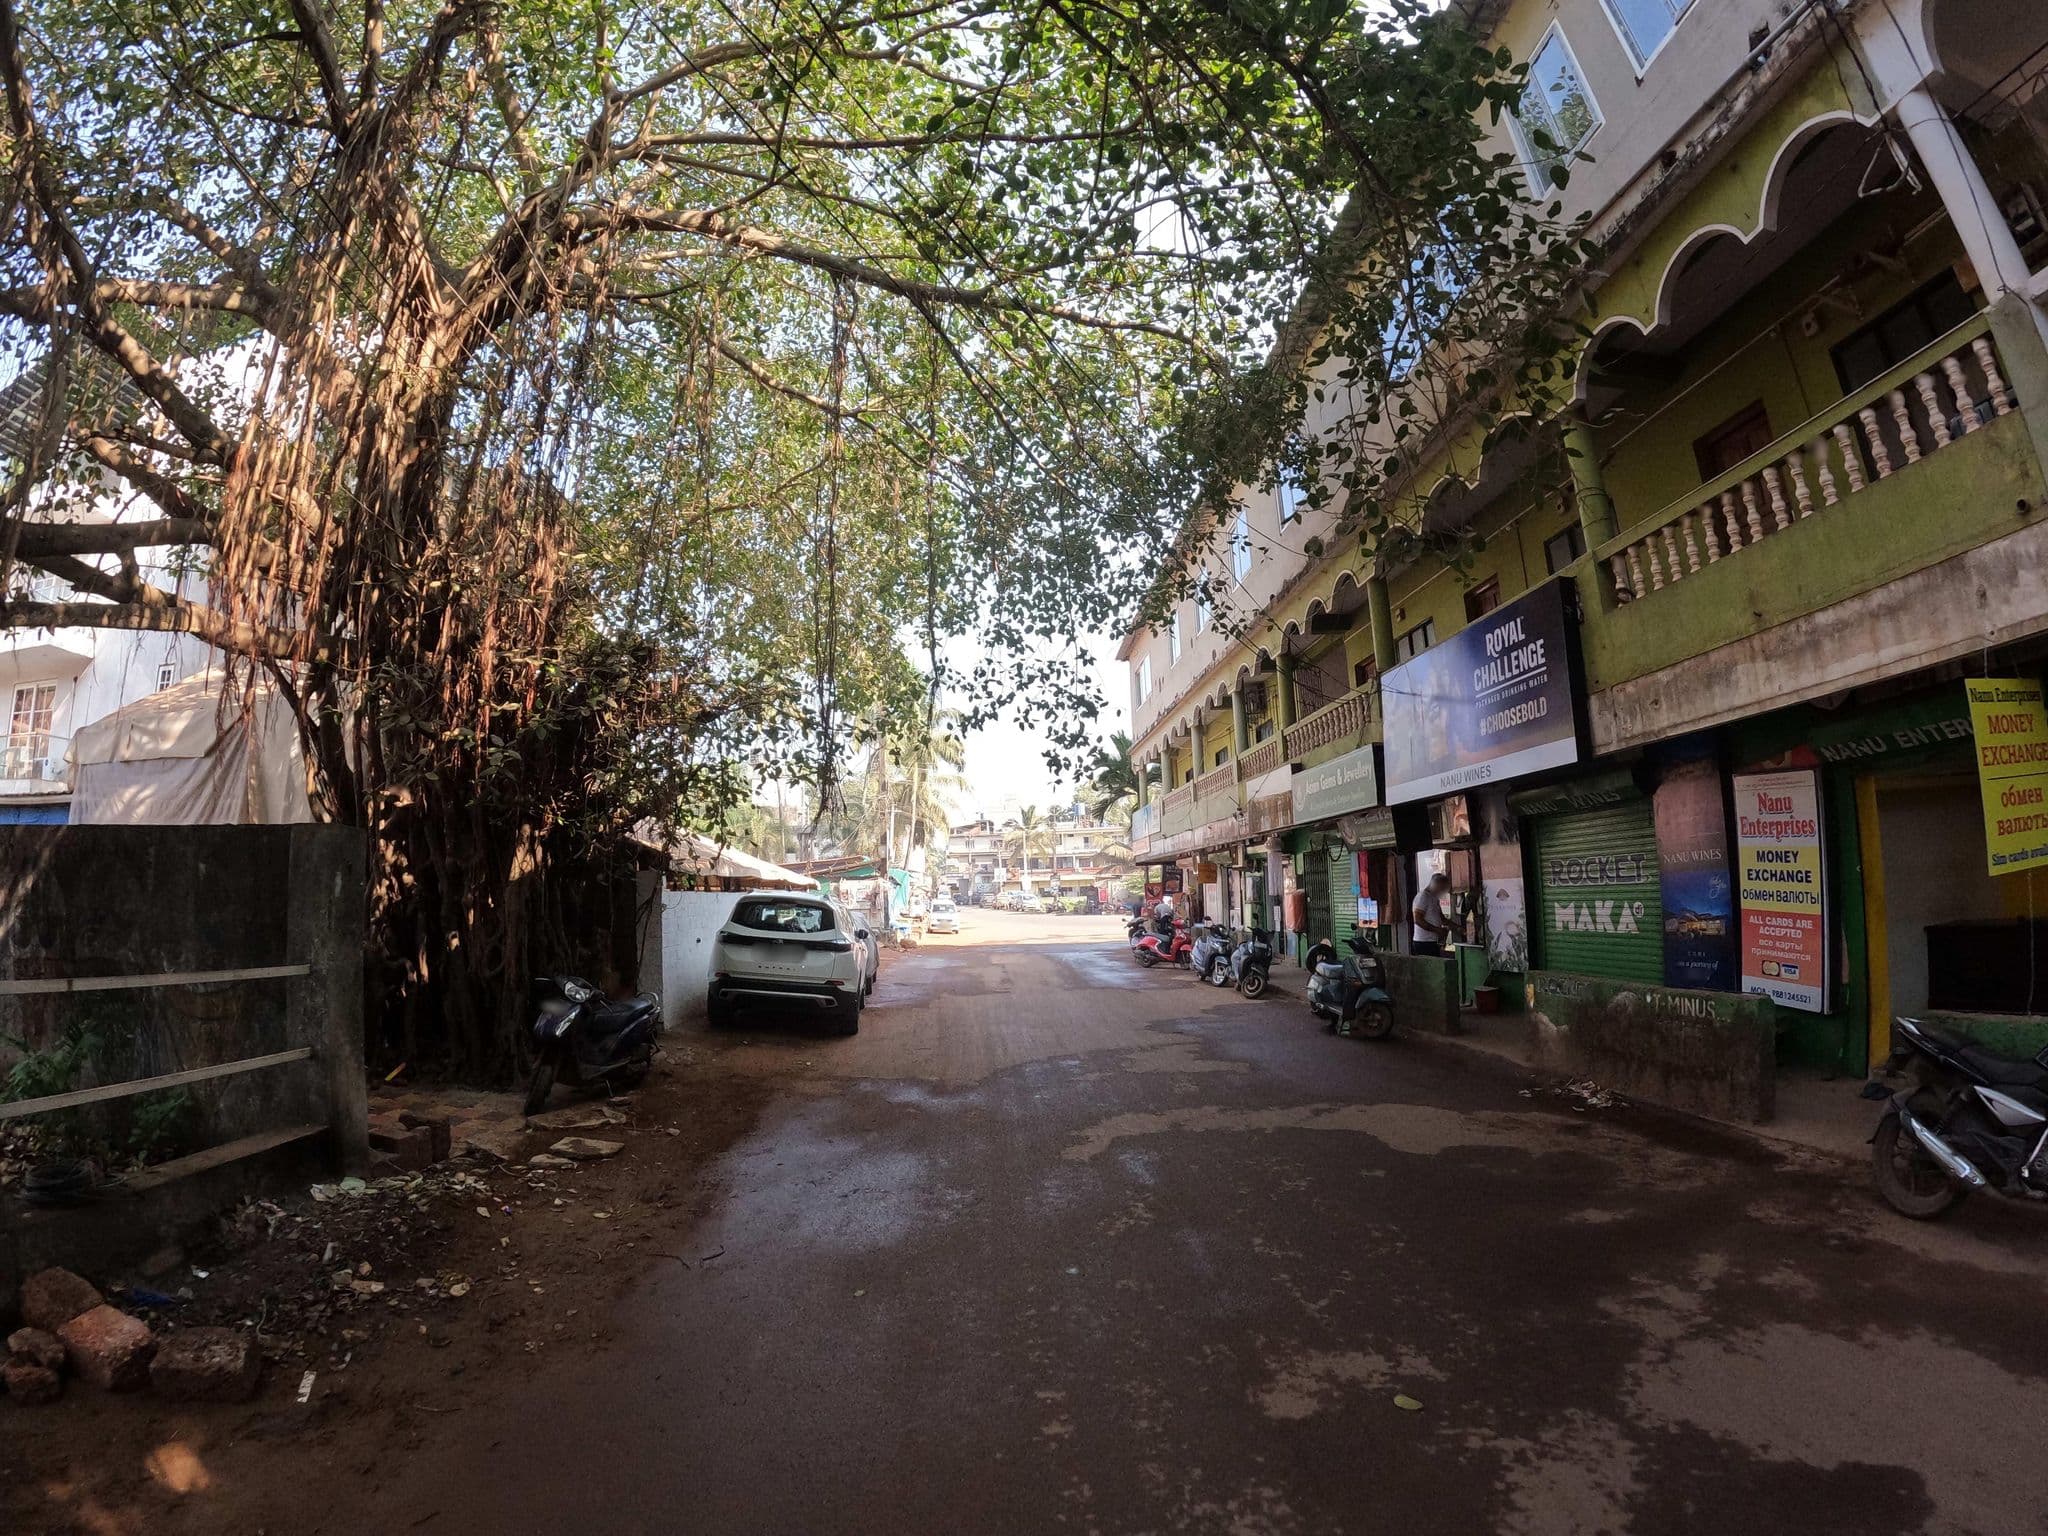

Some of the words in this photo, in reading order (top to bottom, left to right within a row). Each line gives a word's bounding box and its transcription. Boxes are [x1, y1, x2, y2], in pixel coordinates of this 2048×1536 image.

[1485, 616, 1526, 658] ROYAL
[1473, 638, 1546, 691] CHALLENGE
[1529, 673, 1548, 690] WATER
[1969, 687, 1993, 703] Nanu
[1480, 696, 1549, 736] #CHOOSEBOLD
[1987, 713, 2034, 735] MONEY
[1821, 735, 1888, 763] NANU
[1893, 716, 1972, 749] ENTER
[1440, 773, 1463, 788] NANU
[1464, 764, 1492, 783] WINES
[1567, 790, 1622, 811] WINES
[1757, 792, 1794, 815] Nanu
[2000, 785, 2043, 807] обмен
[1740, 815, 1817, 843] Enterprises
[1663, 851, 1690, 864] NANU
[1691, 848, 1722, 862] WINES
[1756, 850, 1800, 864] MONEY
[1548, 853, 1647, 887] ROCKET
[1746, 868, 1813, 884] EXCHANGE
[1776, 890, 1820, 905] валюты
[1554, 900, 1641, 934] MAKA
[1749, 915, 1763, 925] ALL
[1765, 916, 1794, 928] CARDS
[1795, 919, 1814, 929] ARE
[1759, 926, 1803, 939] ACCEPTED
[1783, 967, 1797, 976] VISA
